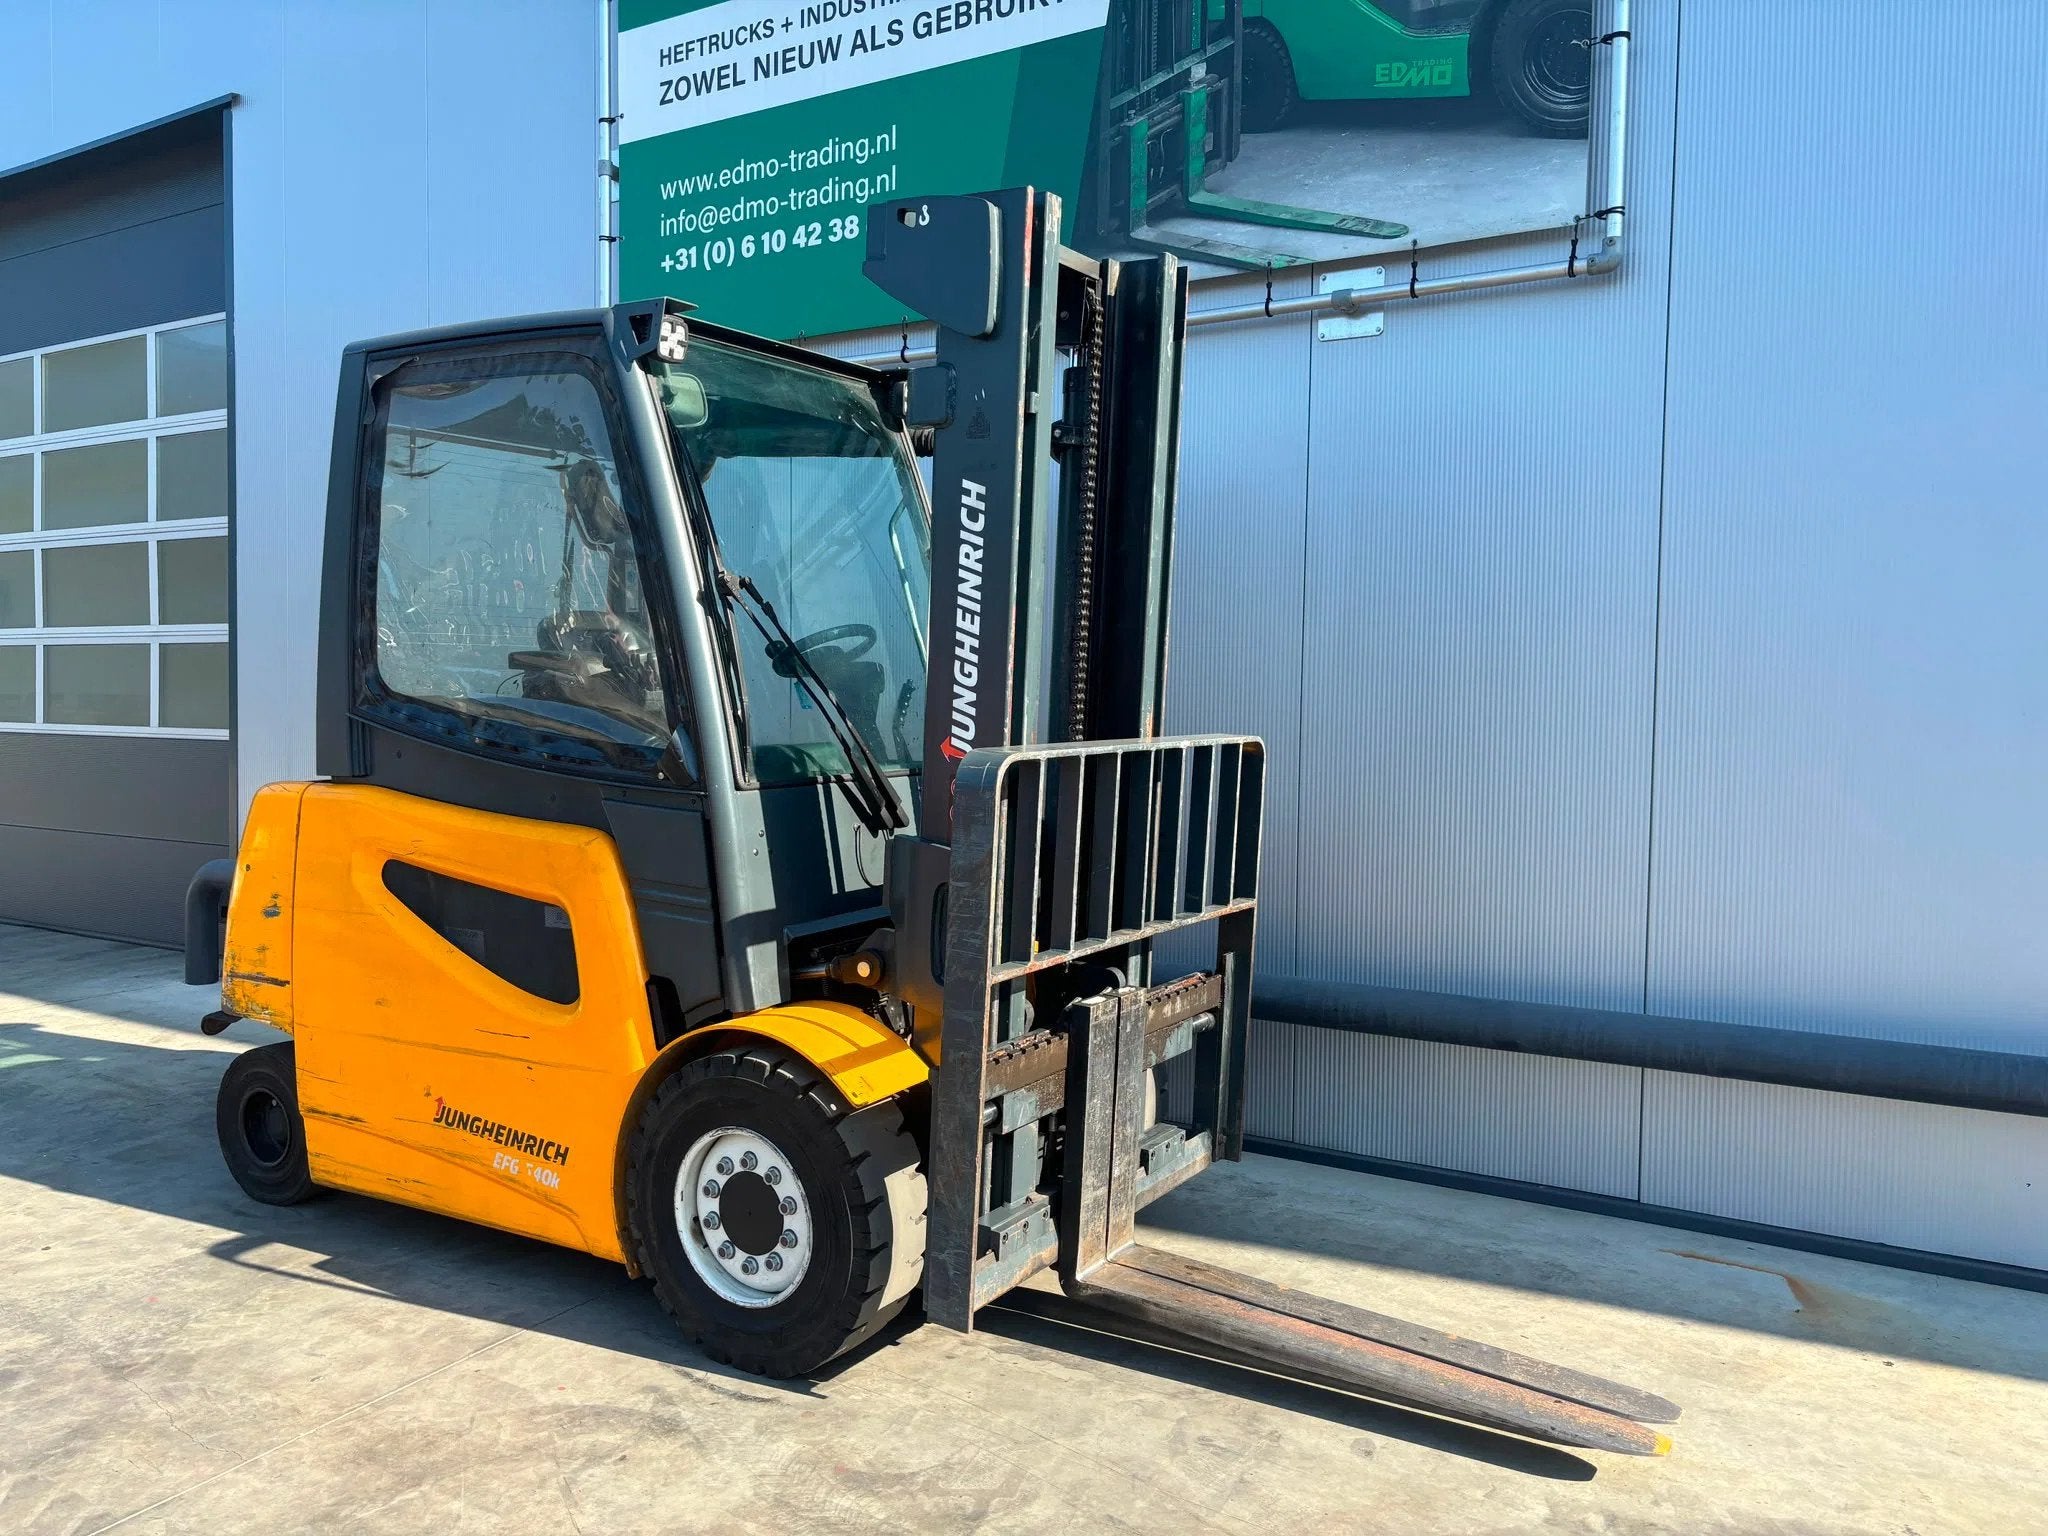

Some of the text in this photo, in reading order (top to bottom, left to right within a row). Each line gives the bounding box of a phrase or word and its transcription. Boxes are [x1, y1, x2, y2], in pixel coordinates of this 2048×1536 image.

[659, 18, 775, 68] HEFTRUCKS
[781, 16, 793, 33] +
[659, 62, 746, 106] ZOWEL
[753, 34, 842, 81] NIEUW
[850, 19, 904, 57] ALS
[1411, 57, 1453, 67] TRADING
[1374, 62, 1453, 88] EDMO
[660, 124, 897, 200] www.edmo-trading.nl
[660, 164, 897, 237] info@edmo-trading.nl
[660, 215, 860, 273] +31 (0) 6 10 42 38
[950, 478, 987, 752] JUNGHEINRICH
[433, 1104, 570, 1167] JUNGHEINRICH
[492, 1151, 520, 1176] EFG
